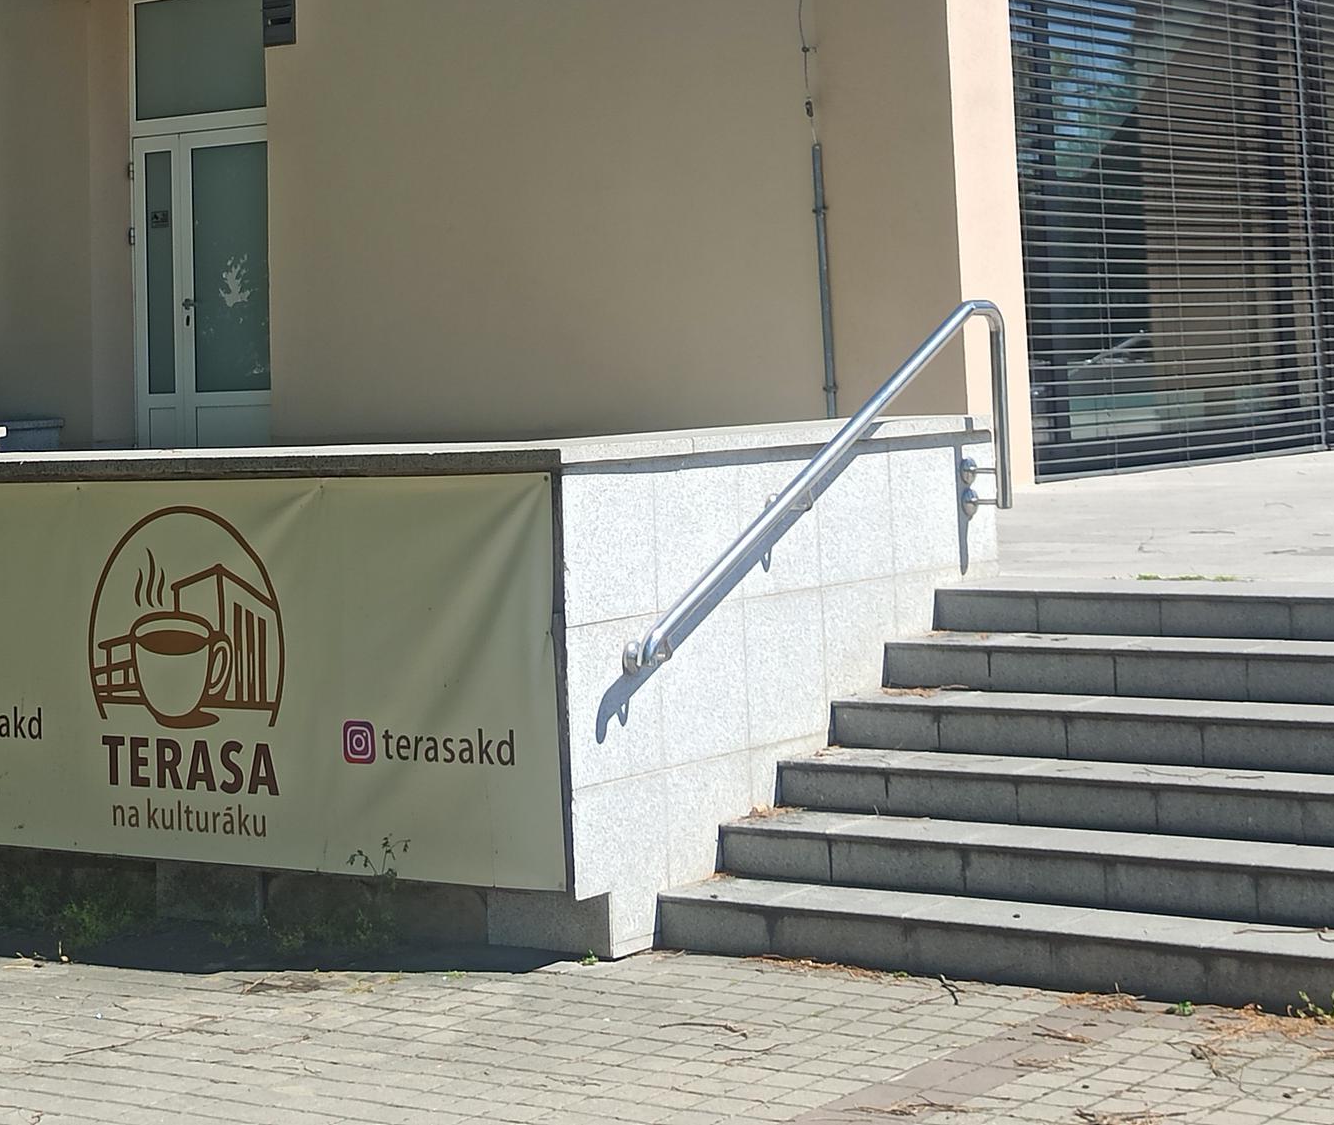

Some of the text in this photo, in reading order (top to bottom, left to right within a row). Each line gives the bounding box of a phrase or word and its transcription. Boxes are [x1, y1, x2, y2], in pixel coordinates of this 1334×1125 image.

[101, 734, 280, 797] TERASA
[382, 728, 516, 766] terasakd
[111, 798, 267, 838] na kulturáku
